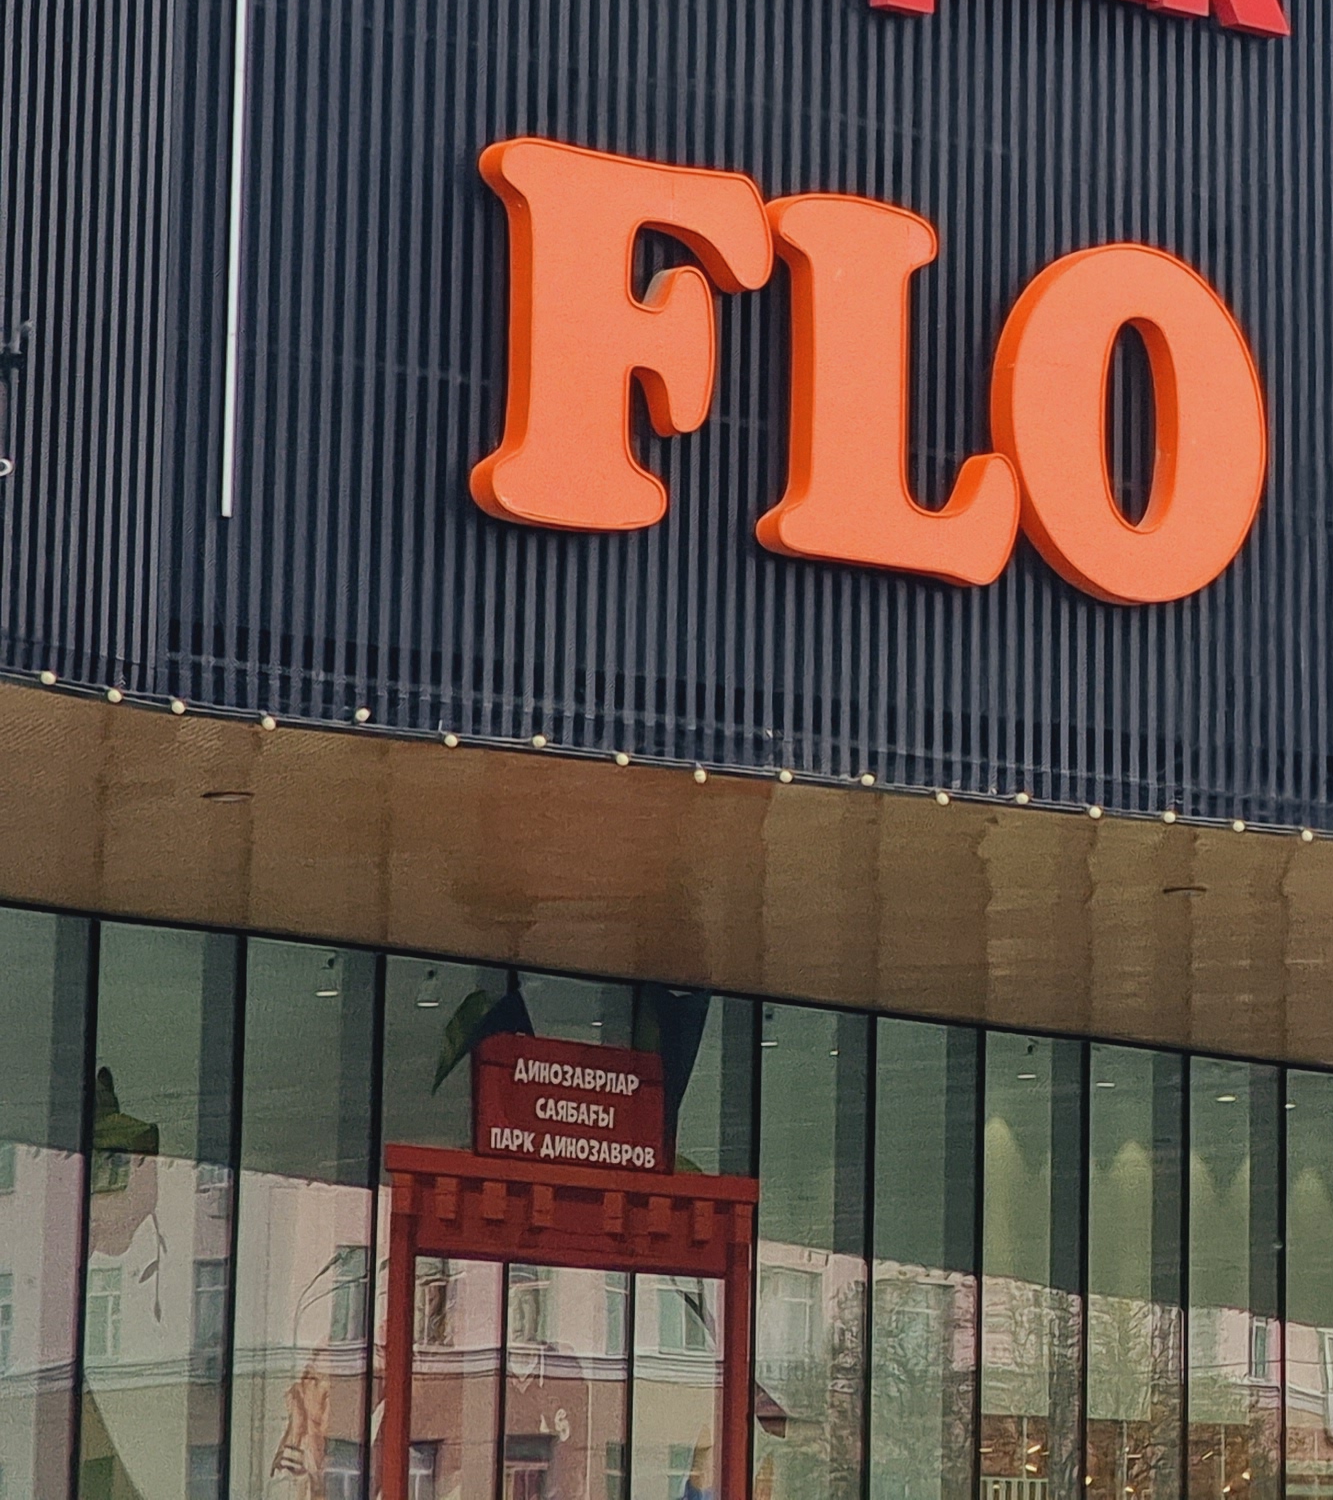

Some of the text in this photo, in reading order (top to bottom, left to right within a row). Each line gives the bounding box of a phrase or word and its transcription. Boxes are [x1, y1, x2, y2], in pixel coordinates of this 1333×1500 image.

[469, 137, 1266, 604] FLO
[514, 1058, 640, 1096] ДИНОЗАВРЛАР
[535, 1097, 615, 1129] САЯБАҒЫ
[490, 1127, 656, 1169] ПАРК ДИНОЗАВРОВ
